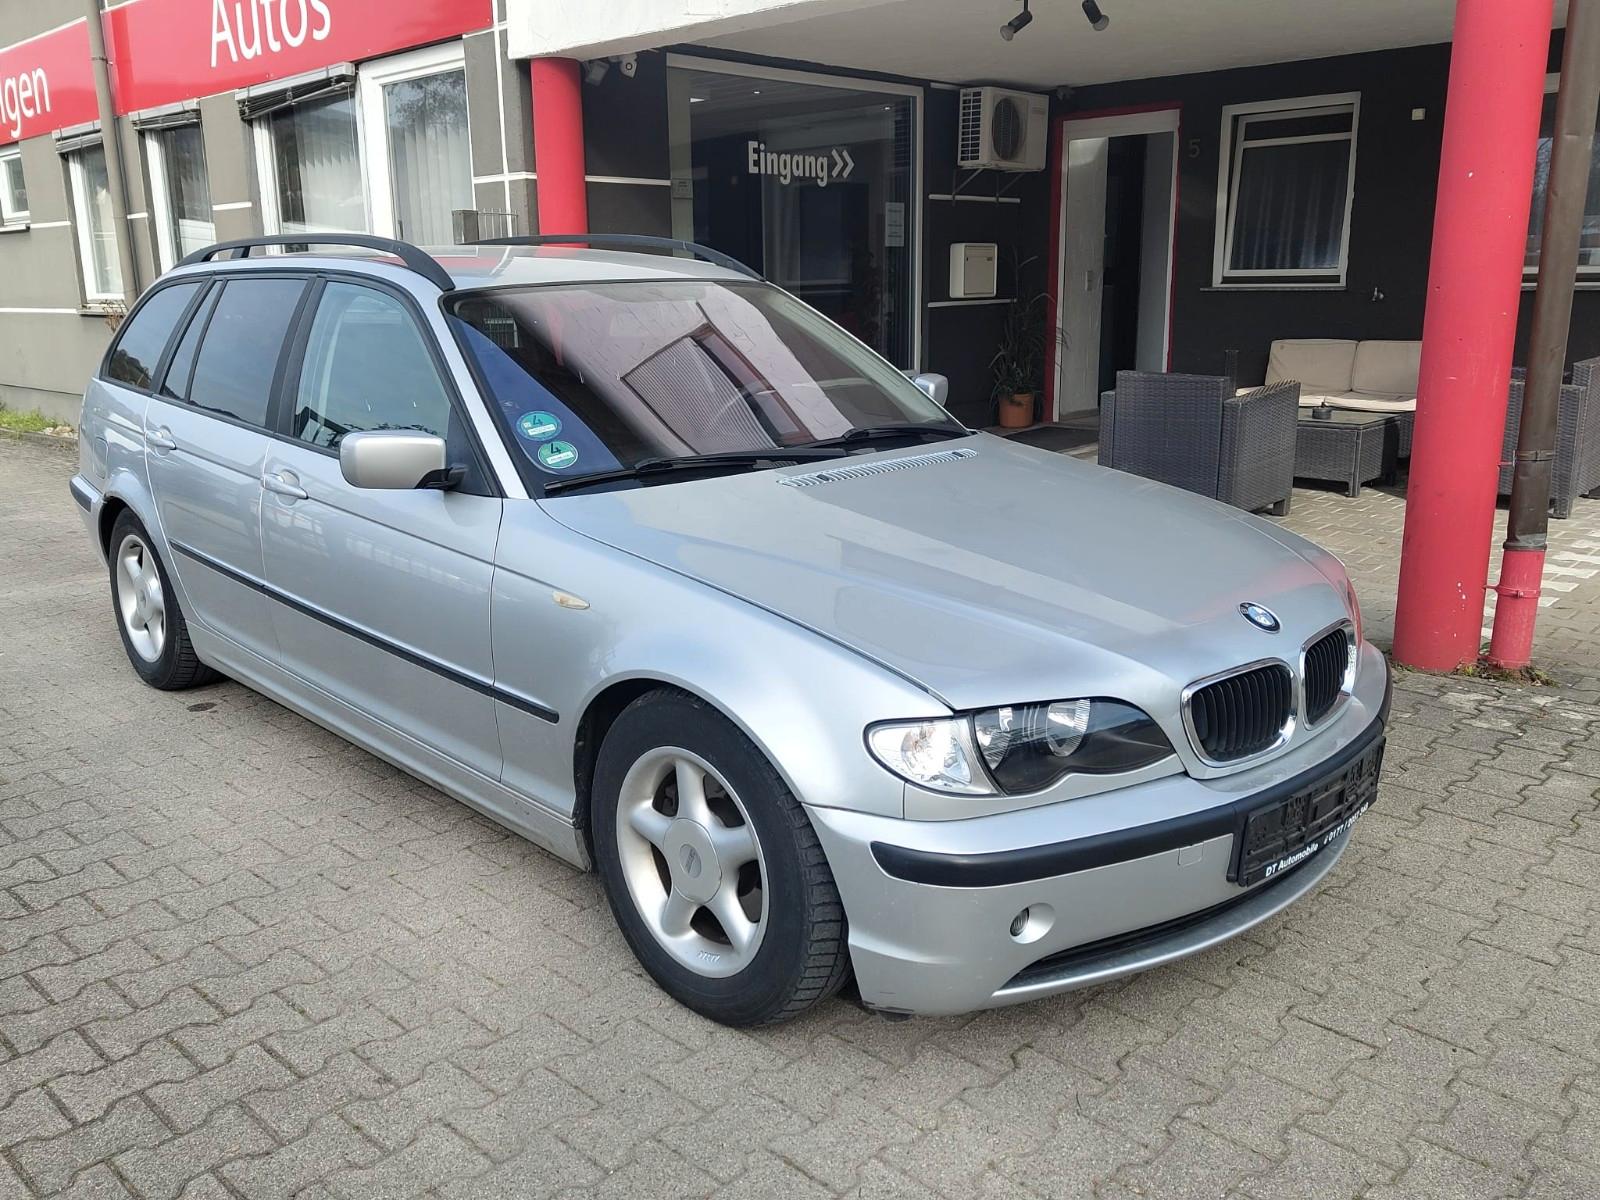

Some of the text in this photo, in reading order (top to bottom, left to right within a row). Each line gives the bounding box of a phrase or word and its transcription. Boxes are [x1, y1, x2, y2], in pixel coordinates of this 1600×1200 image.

[210, 0, 331, 68] Autos
[1189, 138, 1201, 158] 5
[748, 140, 828, 187] Eingang
[533, 415, 543, 425] 4
[551, 443, 561, 454] 4
[1265, 863, 1278, 877] DT
[1278, 843, 1319, 871] Automobile
